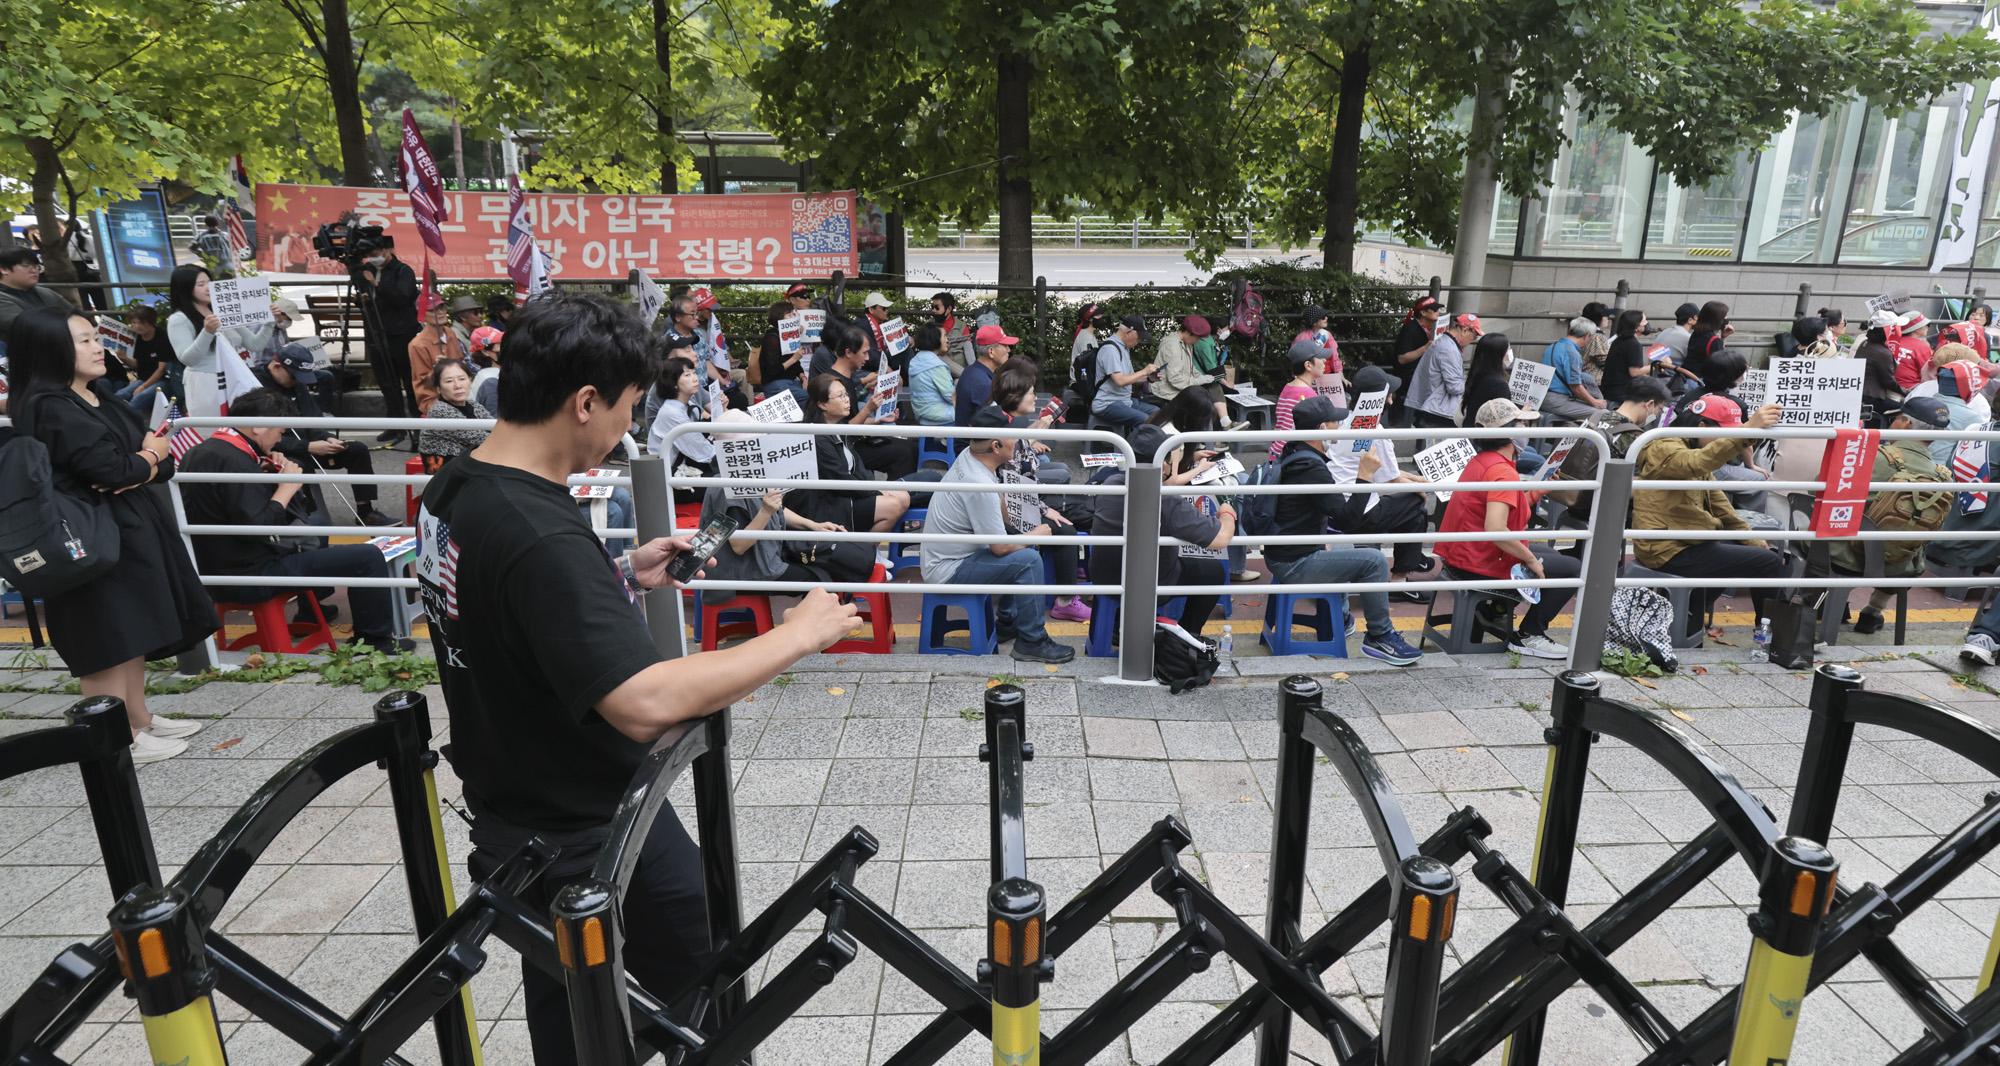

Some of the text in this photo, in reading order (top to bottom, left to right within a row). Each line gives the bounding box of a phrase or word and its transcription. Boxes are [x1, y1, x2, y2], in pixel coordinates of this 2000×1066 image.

[478, 196, 590, 233] 무비자
[602, 197, 675, 233] 입국
[582, 238, 660, 276] 아닌
[677, 237, 782, 275] 점령?
[793, 257, 811, 266] 6.3
[829, 267, 852, 275] SAL
[214, 281, 238, 292] 중국인
[216, 288, 269, 304] 관광객 유치보다
[218, 303, 242, 314] 자국민
[220, 311, 269, 327] 안전이 먼저다!
[1517, 361, 1536, 373] 중국인
[1777, 360, 1816, 375] 중국인
[1745, 372, 1768, 383] 국인
[1776, 376, 1862, 392] 관광객 유치보다
[1738, 393, 1765, 404] 자국민
[1775, 394, 1812, 407] 자국민
[1813, 411, 1850, 425] 먼저다!
[722, 439, 760, 454] 중국인
[725, 440, 813, 468] 관광객 유치보다
[728, 468, 766, 479] 자국민
